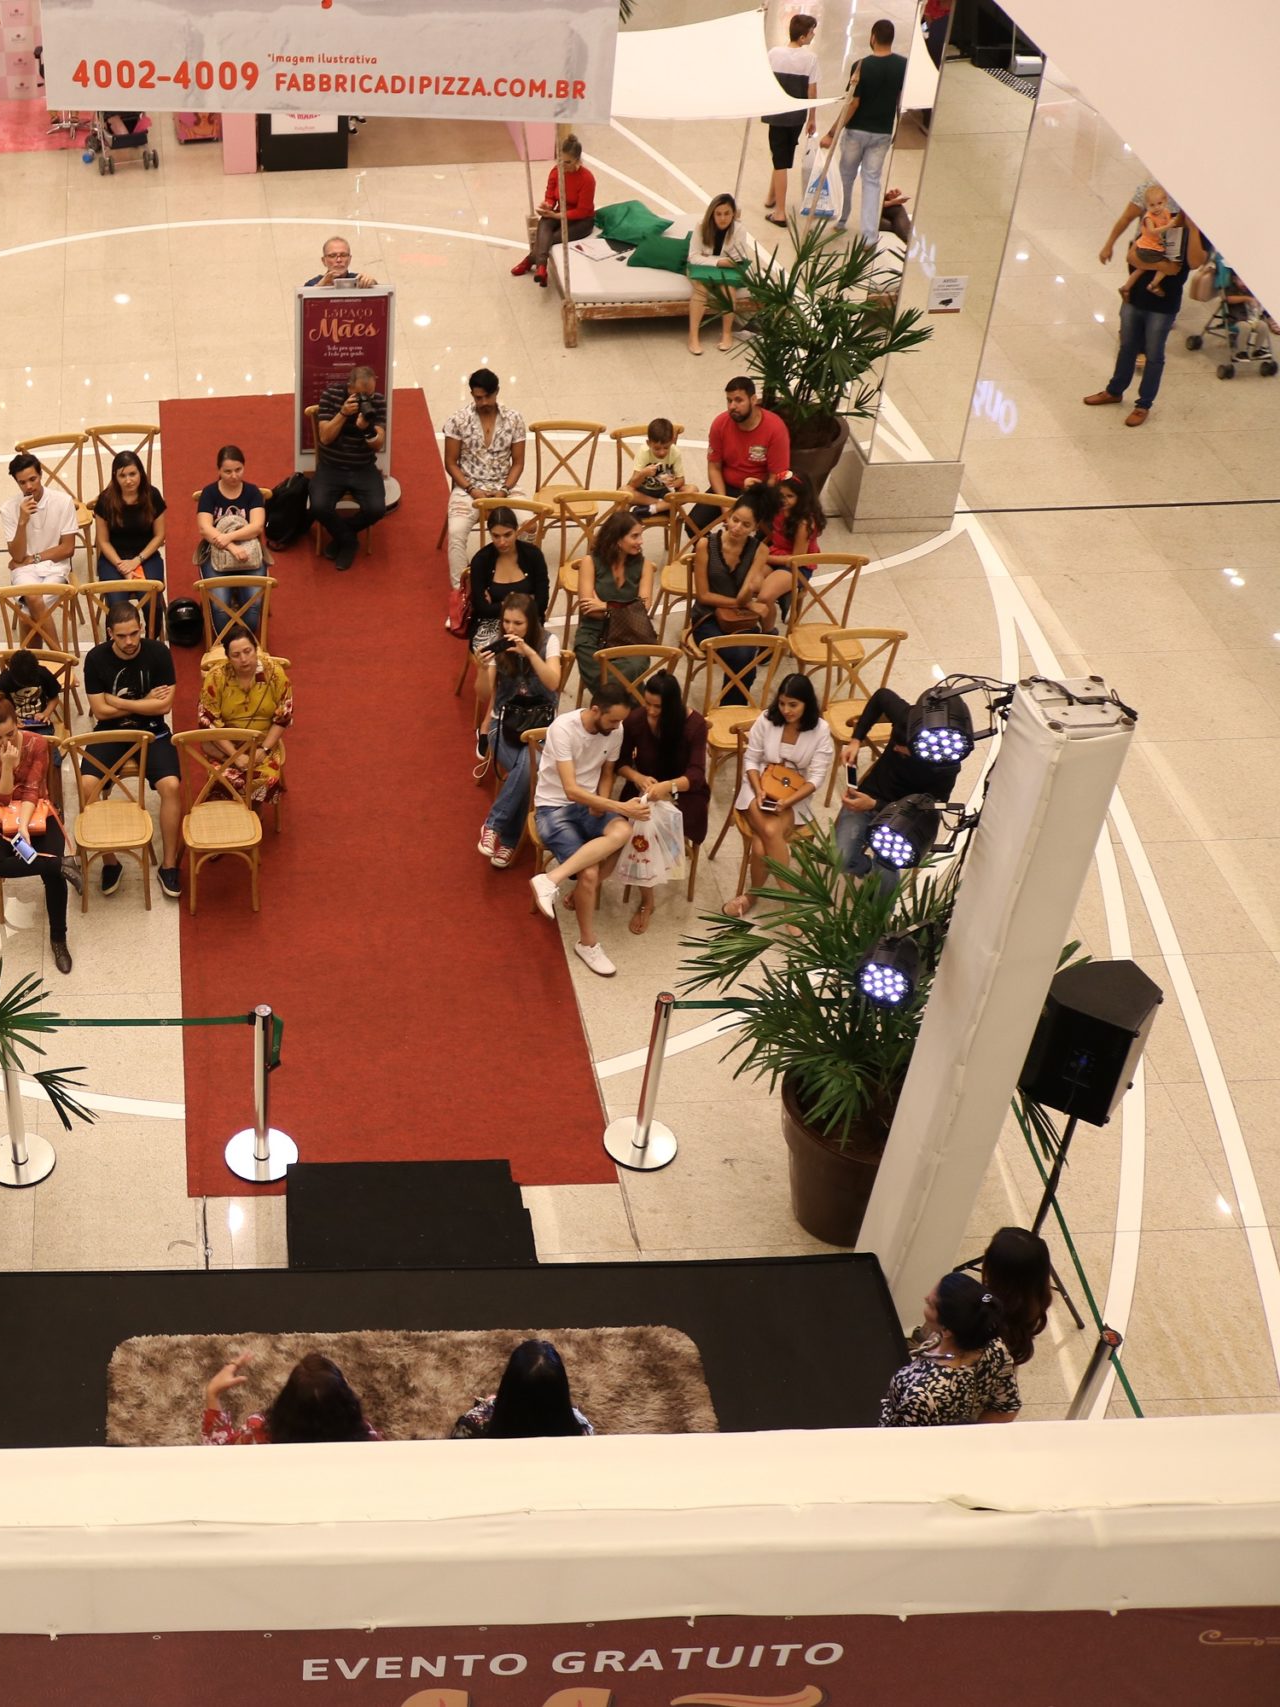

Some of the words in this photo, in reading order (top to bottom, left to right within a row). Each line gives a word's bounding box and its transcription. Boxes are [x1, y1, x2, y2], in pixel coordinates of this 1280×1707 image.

[317, 53, 378, 65] ilustrativa
[72, 59, 260, 91] 4002-4009
[274, 72, 587, 100] FABBRICADIPIZZA.COM.BR
[308, 318, 380, 343] Mães
[302, 1653, 528, 1681] EVENTO
[551, 1642, 844, 1674] GRATUITO
